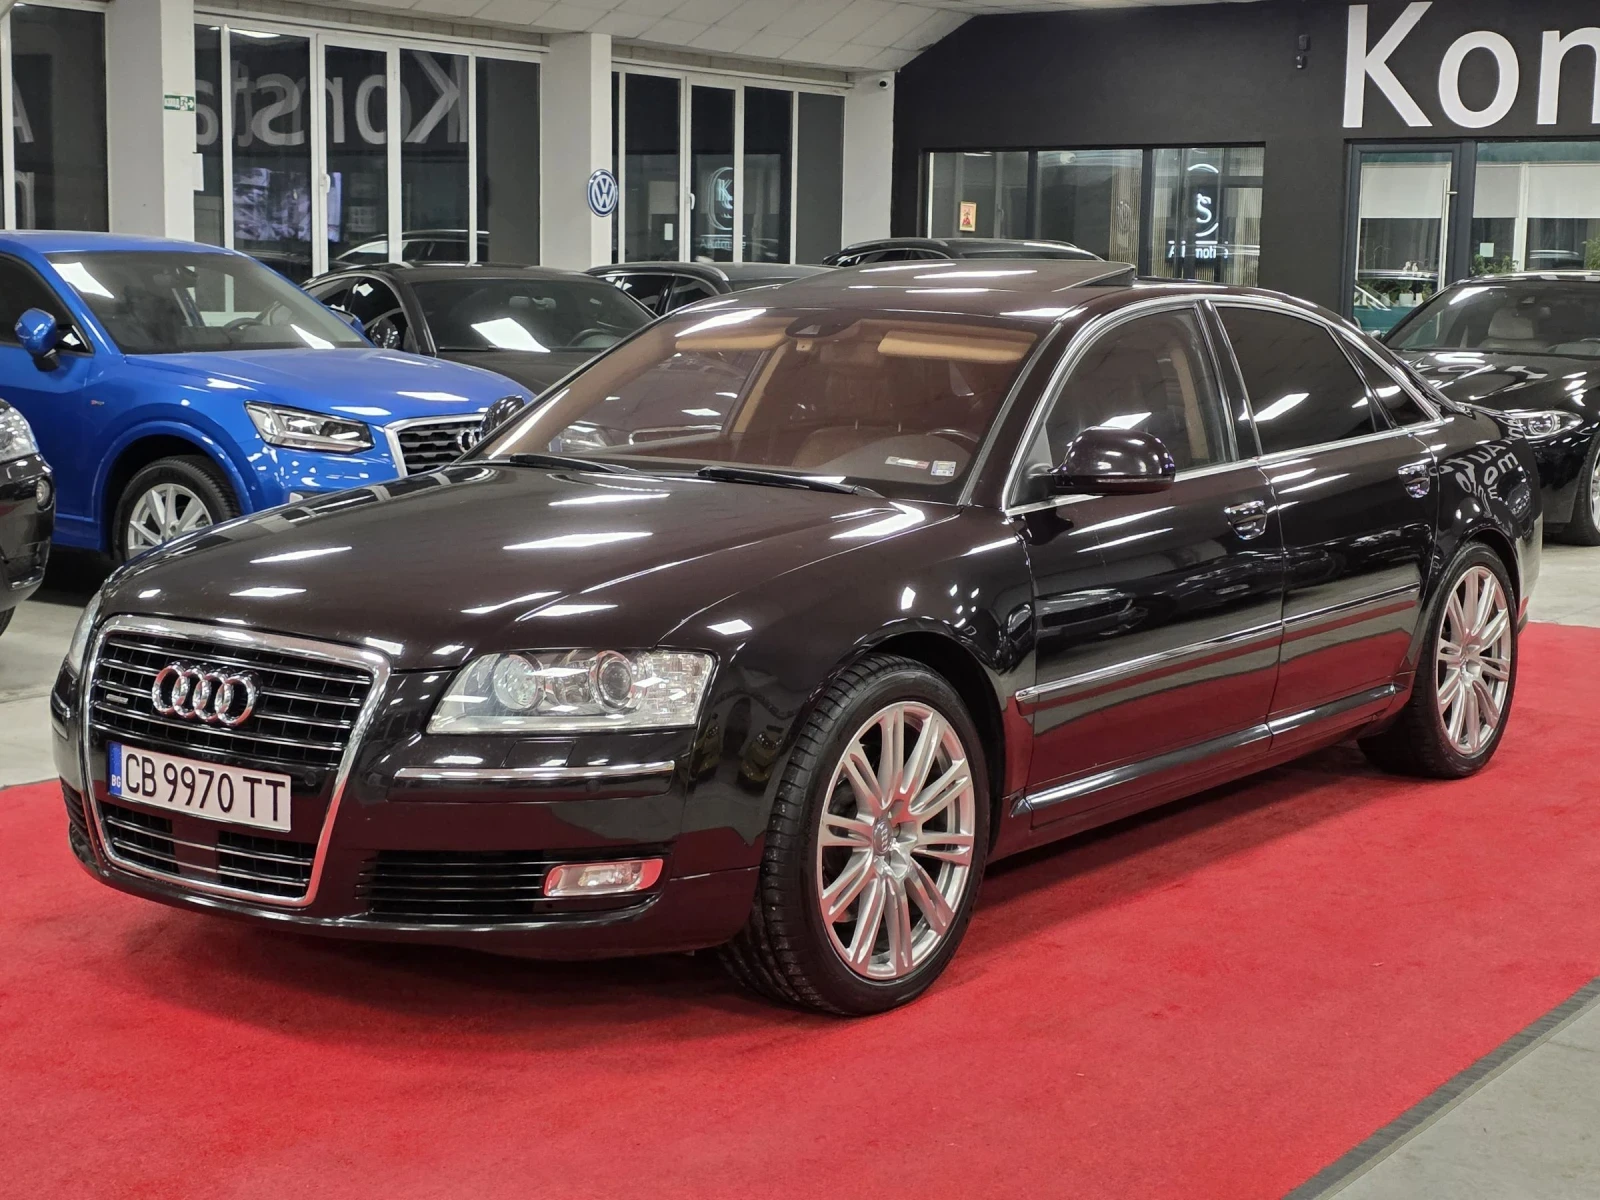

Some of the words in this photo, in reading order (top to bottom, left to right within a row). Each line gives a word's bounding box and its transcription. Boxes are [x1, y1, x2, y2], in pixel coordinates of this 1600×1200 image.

[1343, 2, 1600, 128] Kon
[111, 774, 122, 787] BG
[125, 753, 157, 797] CB
[163, 762, 234, 813] 9970
[243, 776, 286, 821] TT
